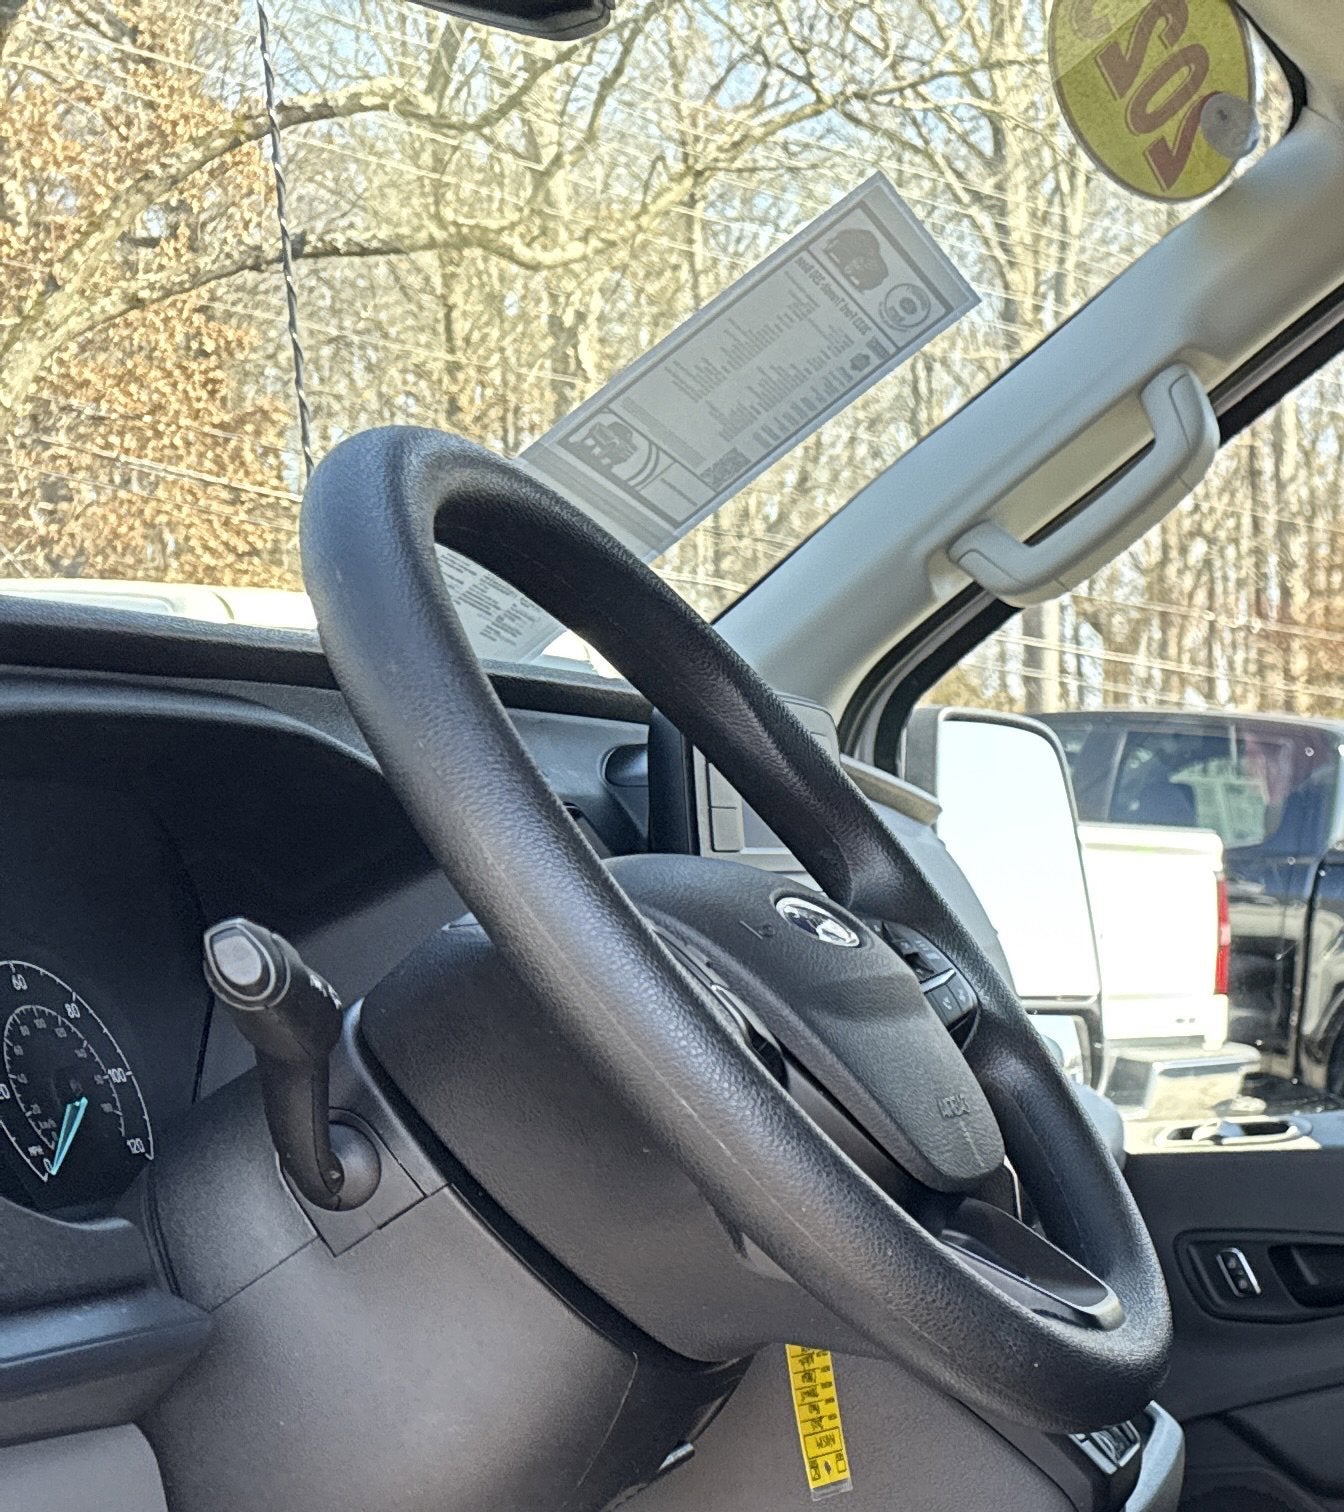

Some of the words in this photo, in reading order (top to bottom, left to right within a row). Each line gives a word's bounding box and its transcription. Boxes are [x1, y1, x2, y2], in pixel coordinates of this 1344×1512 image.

[12, 974, 28, 990] 60
[65, 1002, 80, 1018] 80
[108, 1067, 127, 1082] 100
[127, 1137, 145, 1154] 120
